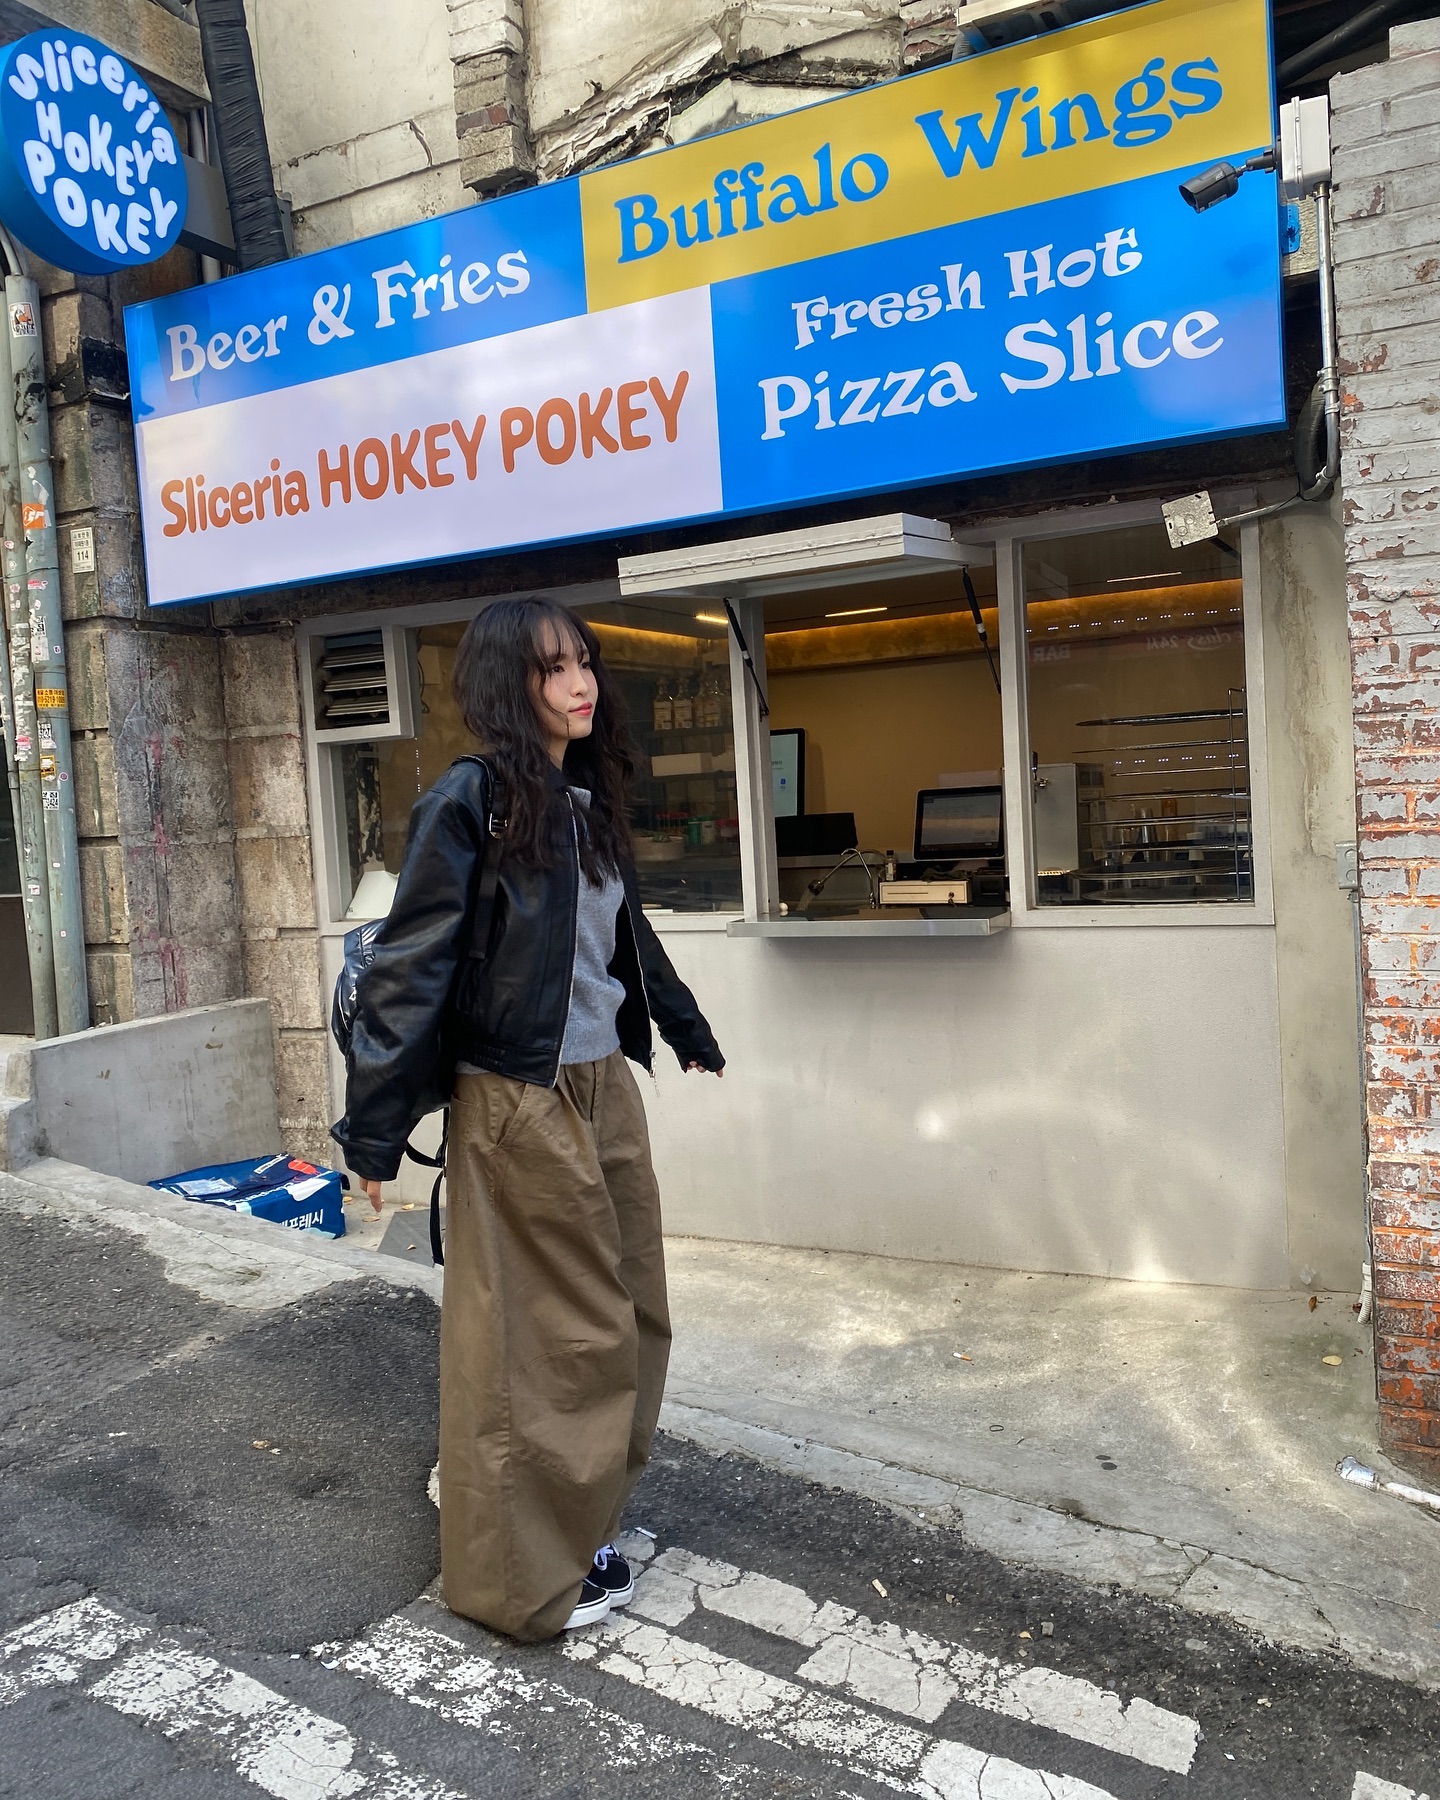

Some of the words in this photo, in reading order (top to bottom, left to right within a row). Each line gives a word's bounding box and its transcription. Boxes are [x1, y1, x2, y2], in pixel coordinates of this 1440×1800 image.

[9, 40, 177, 165] Sliceria
[36, 101, 154, 196] HOKEY
[615, 144, 889, 263] Buffalo
[915, 57, 1223, 178] Wings
[24, 140, 178, 254] POKEY
[166, 313, 288, 382] Beer
[307, 284, 355, 345] &
[372, 249, 531, 329] Fries
[792, 263, 985, 350] Fresh
[1004, 227, 1143, 299] Hot
[758, 360, 978, 440] Pizza
[1001, 310, 1225, 393] Slice
[161, 458, 310, 538] Sliceria
[319, 414, 487, 507] HOKEY
[501, 370, 690, 473] POKEY
